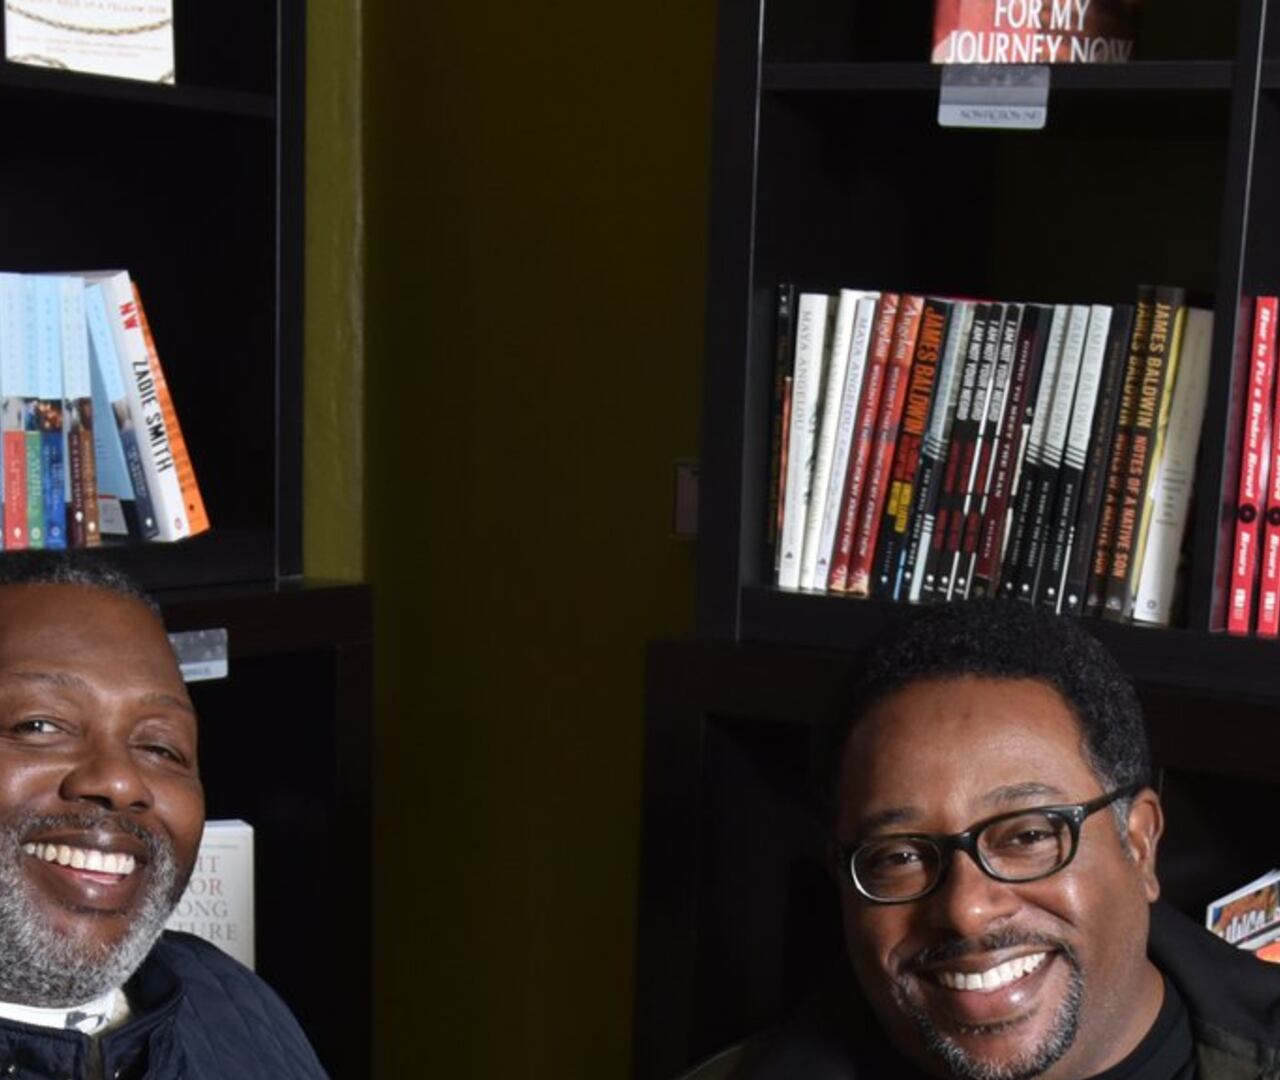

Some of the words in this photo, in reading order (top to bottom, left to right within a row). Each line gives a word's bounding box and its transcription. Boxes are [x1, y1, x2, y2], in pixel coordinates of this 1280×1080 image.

[993, 0, 1042, 29] FOR
[1050, 0, 1093, 31] MY
[945, 29, 1063, 64] JOURNEY
[1070, 35, 1134, 64] NOW
[916, 305, 945, 362] JAMES
[1149, 302, 1171, 353] JAMES
[131, 359, 159, 407] ZADIE
[145, 413, 174, 473] SMITH
[903, 362, 935, 436] BALDWIN
[1136, 356, 1163, 429] BALDWIN
